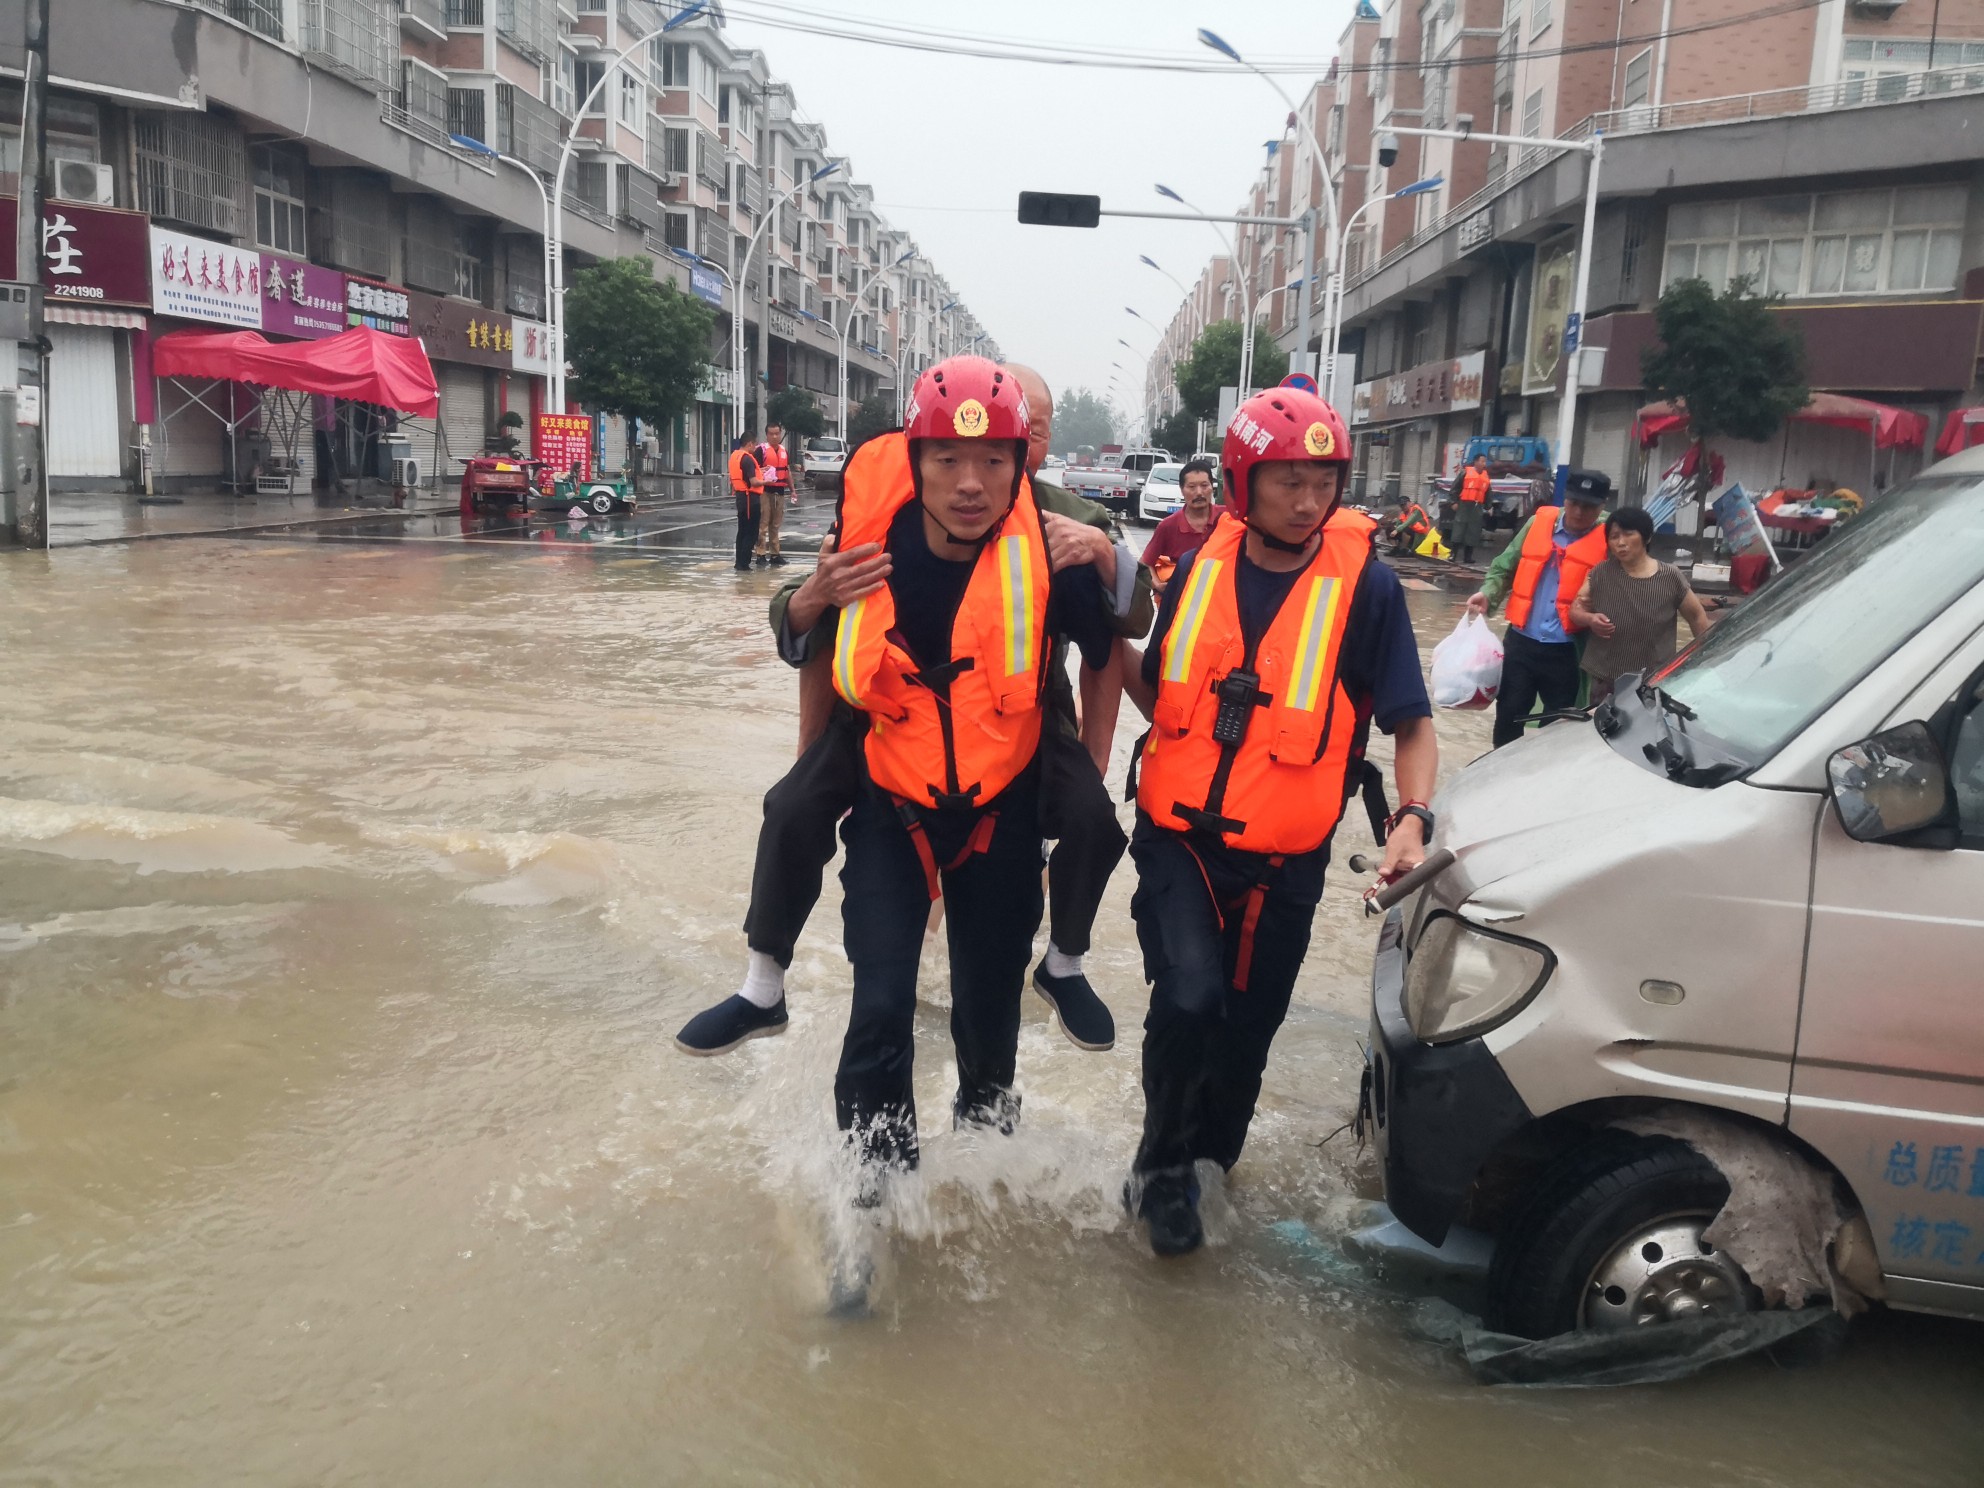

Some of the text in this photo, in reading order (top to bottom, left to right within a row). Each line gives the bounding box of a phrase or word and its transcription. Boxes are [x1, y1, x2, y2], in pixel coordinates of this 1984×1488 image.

[162, 243, 259, 295] 好又来美食馆
[54, 284, 104, 299] 2241908
[540, 416, 589, 431] 好又来美食馆
[1889, 1212, 1984, 1266] 核定
